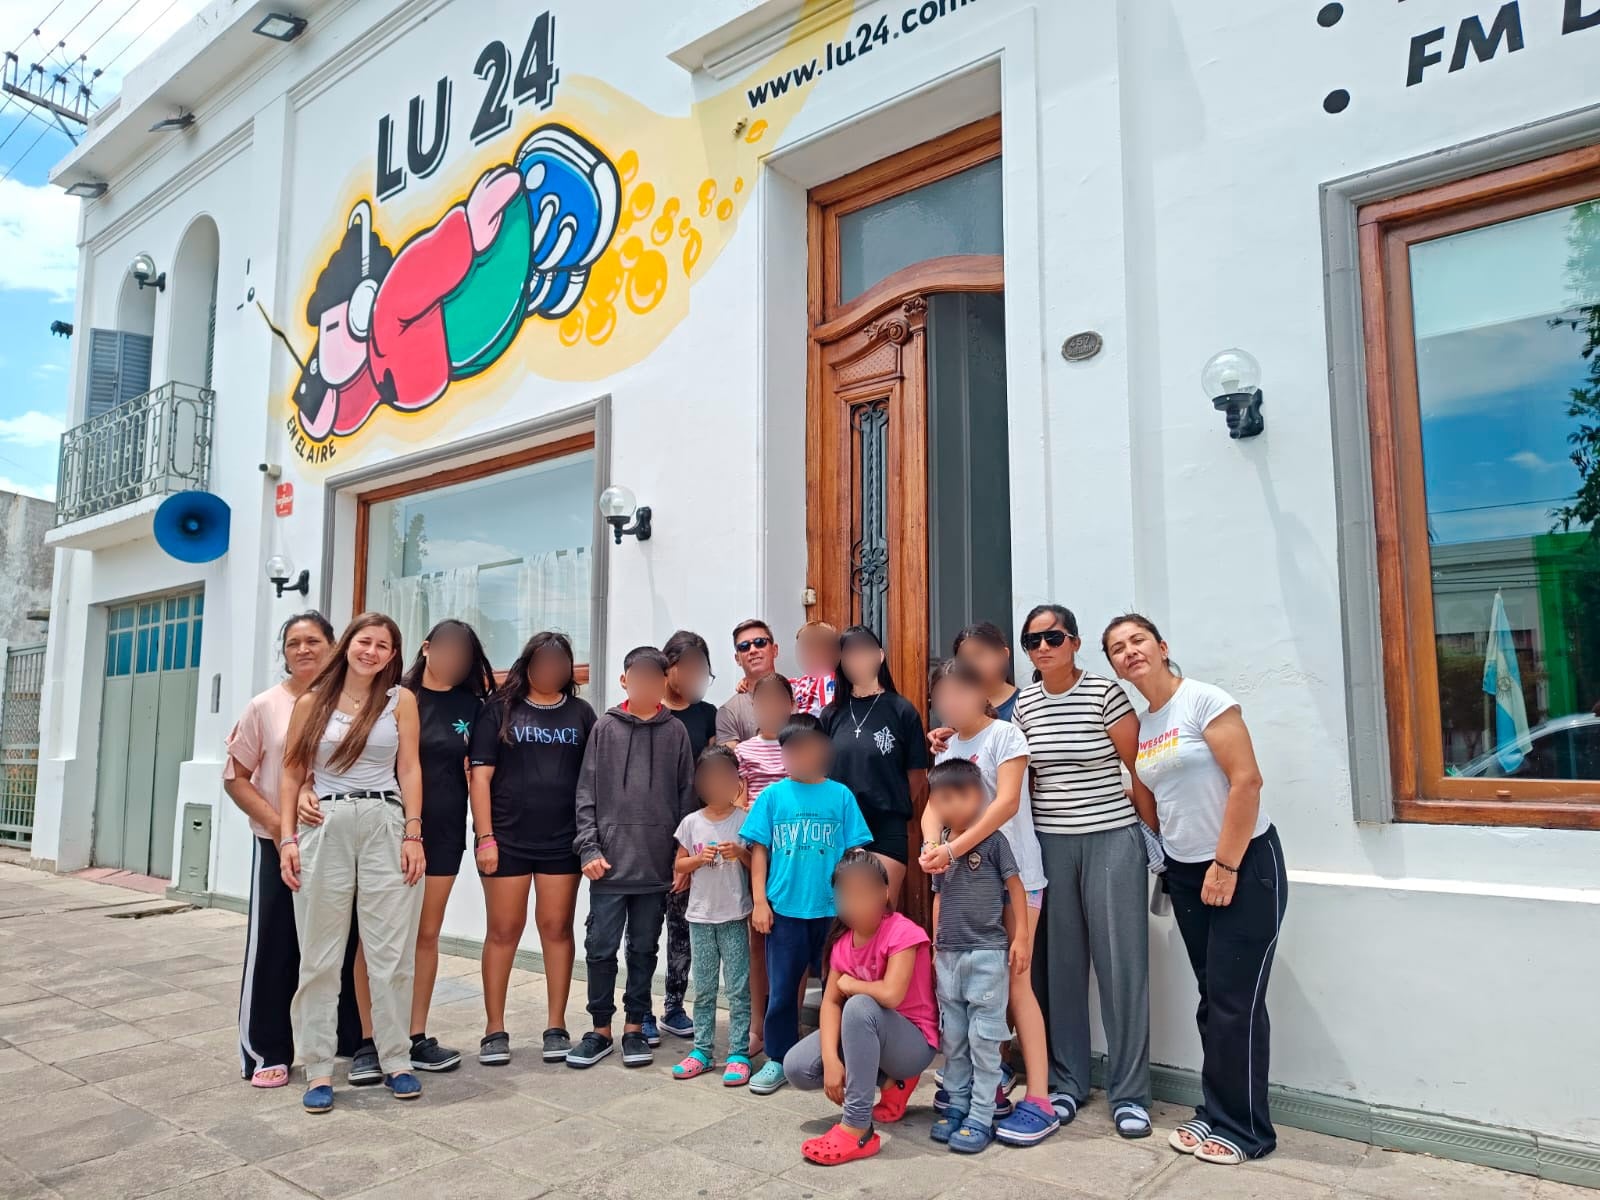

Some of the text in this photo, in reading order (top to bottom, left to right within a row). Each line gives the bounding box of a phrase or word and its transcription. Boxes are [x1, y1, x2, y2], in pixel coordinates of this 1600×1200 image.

[747, 0, 976, 108] www.lu24.com
[1406, 0, 1524, 87] FM
[376, 10, 559, 201] LU 24
[287, 415, 336, 464] EN EL AIRE
[513, 726, 579, 745] VERSACE
[1138, 737, 1179, 760] WESOME
[1139, 728, 1179, 750] WESOME
